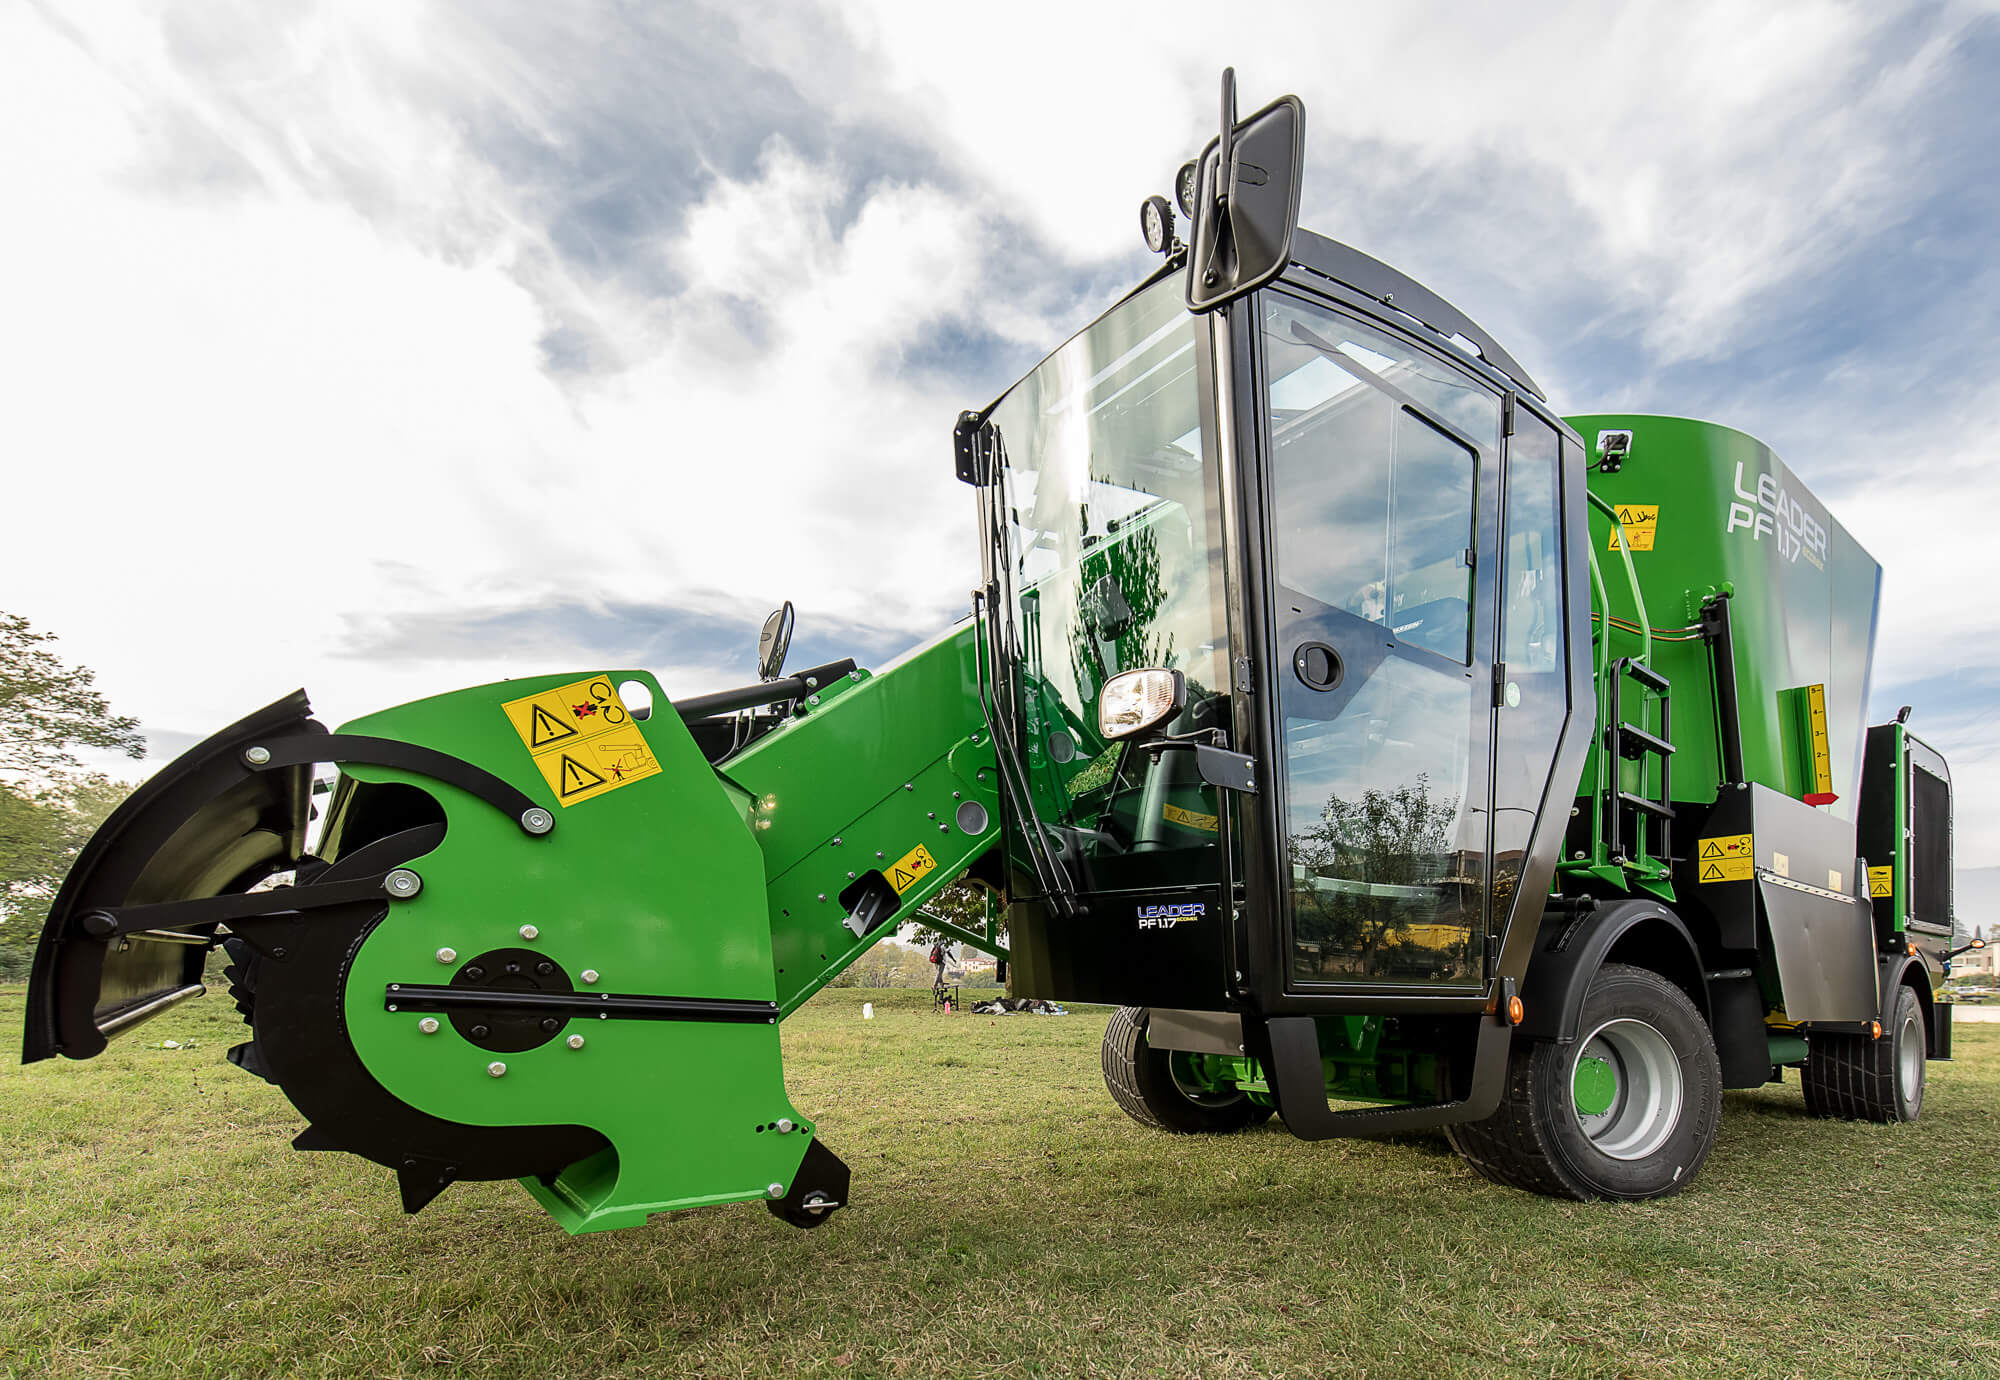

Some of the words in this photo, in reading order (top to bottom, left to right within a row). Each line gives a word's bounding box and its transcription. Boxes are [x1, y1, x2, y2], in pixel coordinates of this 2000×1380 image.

[1734, 461, 1826, 561] LEADER
[1727, 502, 1773, 540] PF
[1777, 521, 1801, 563] 1.17
[1137, 903, 1205, 918] LEADER
[1139, 919, 1156, 929] PF
[1158, 918, 1176, 928] 1.17
